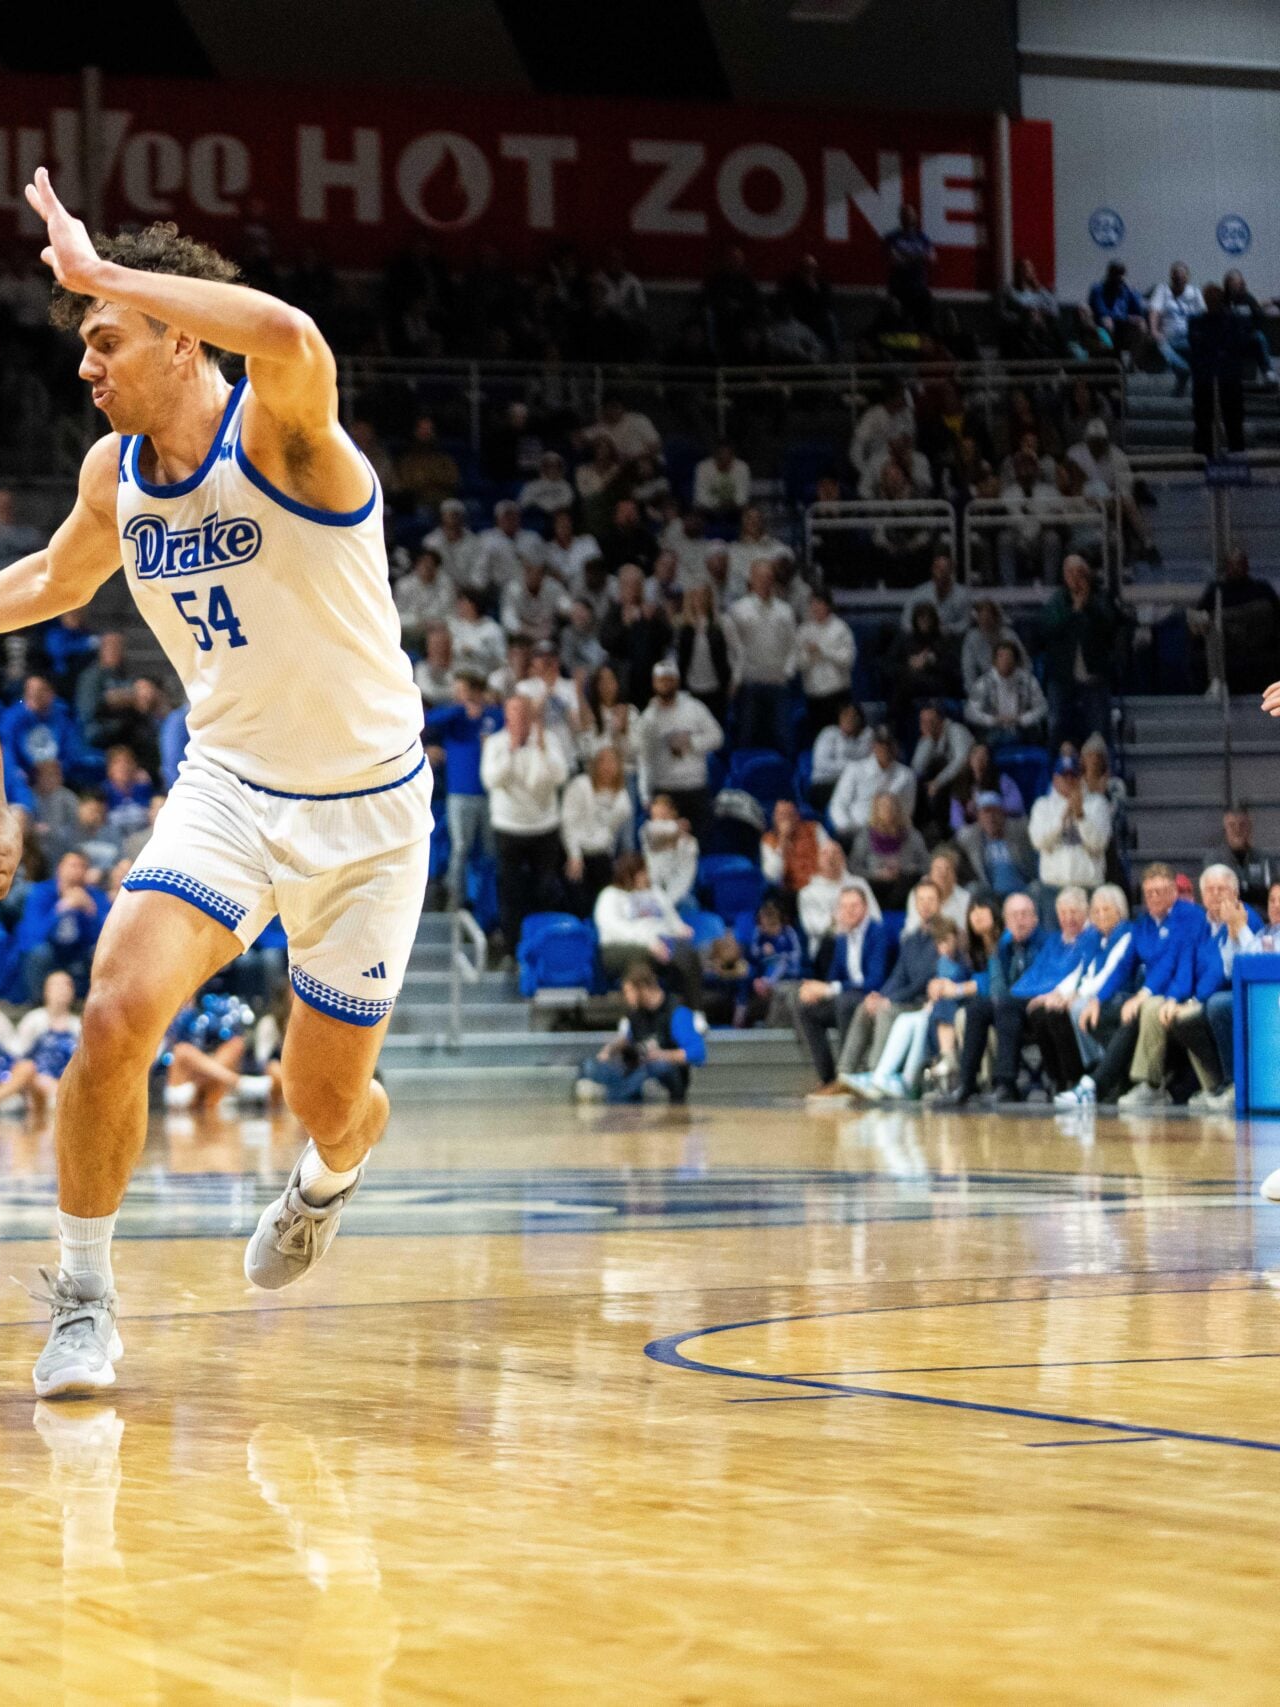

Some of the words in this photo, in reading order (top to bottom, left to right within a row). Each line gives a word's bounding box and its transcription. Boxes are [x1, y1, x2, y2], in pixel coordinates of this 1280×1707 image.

[297, 124, 578, 230] HOT
[629, 140, 986, 247] ZONE
[123, 512, 262, 580] Drake
[171, 585, 249, 652] 54
